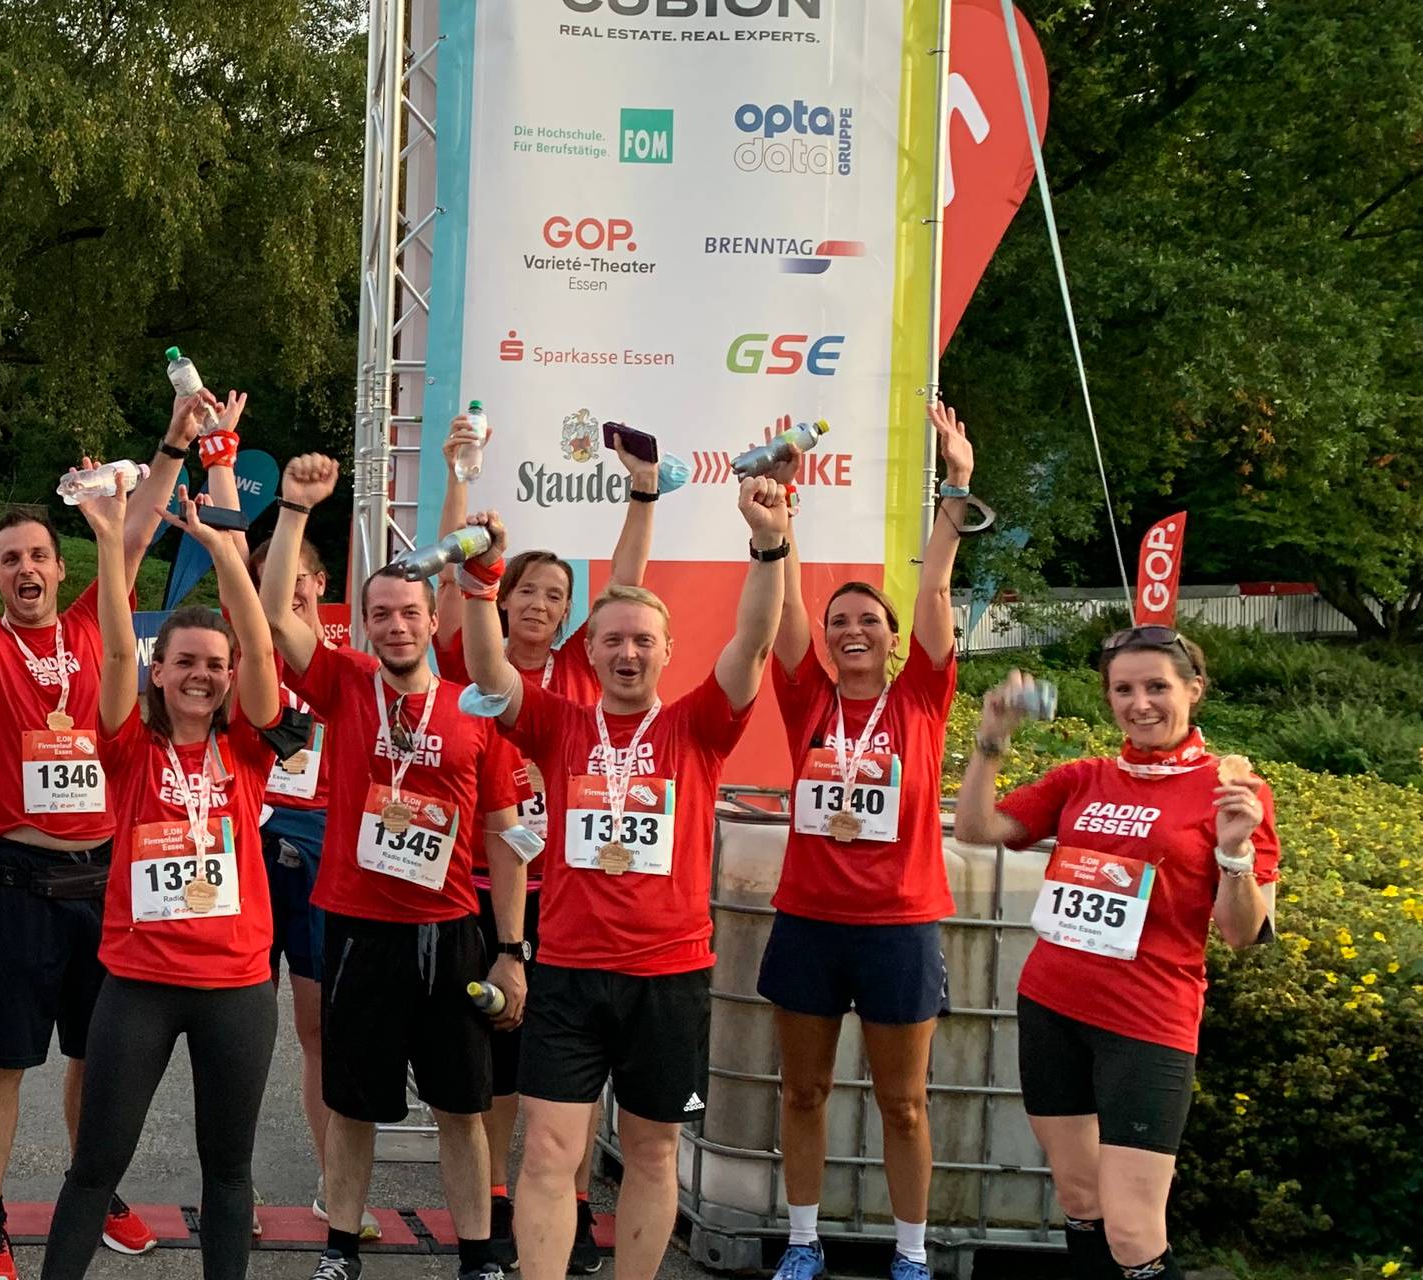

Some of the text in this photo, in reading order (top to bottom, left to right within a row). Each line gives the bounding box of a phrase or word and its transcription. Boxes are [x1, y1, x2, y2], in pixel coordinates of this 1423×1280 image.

[559, 24, 821, 44] REAL ESTATE. REAL EXPERTS.
[734, 100, 835, 139] opta
[513, 124, 606, 142] Die Hochschule.
[623, 129, 668, 160] FOM
[837, 107, 853, 176] GRUPPE
[513, 141, 610, 158] Für Berufstätige.
[733, 138, 835, 175] data
[542, 215, 638, 253] GOP.
[704, 237, 814, 256] BRENNTAG
[523, 254, 657, 275] Varieté-Theater
[568, 276, 609, 292] Essen
[533, 346, 675, 367] Sparkasse Essen
[725, 333, 846, 376] GSE
[236, 475, 263, 496] WE
[1142, 522, 1176, 613] GOP.
[38, 764, 99, 790] 1346
[159, 786, 229, 809] ESSN
[516, 791, 545, 816] 13
[812, 784, 885, 815] 1340
[1081, 801, 1162, 823] RADIO
[581, 813, 659, 846] 1333
[1073, 815, 1153, 839] ESSEN
[143, 836, 183, 846] Firmenlauf
[162, 843, 185, 851] Essen
[374, 820, 443, 863] 1345
[163, 895, 185, 903] Radio
[1051, 886, 1128, 929] 1335
[1078, 924, 1103, 936] Essen
